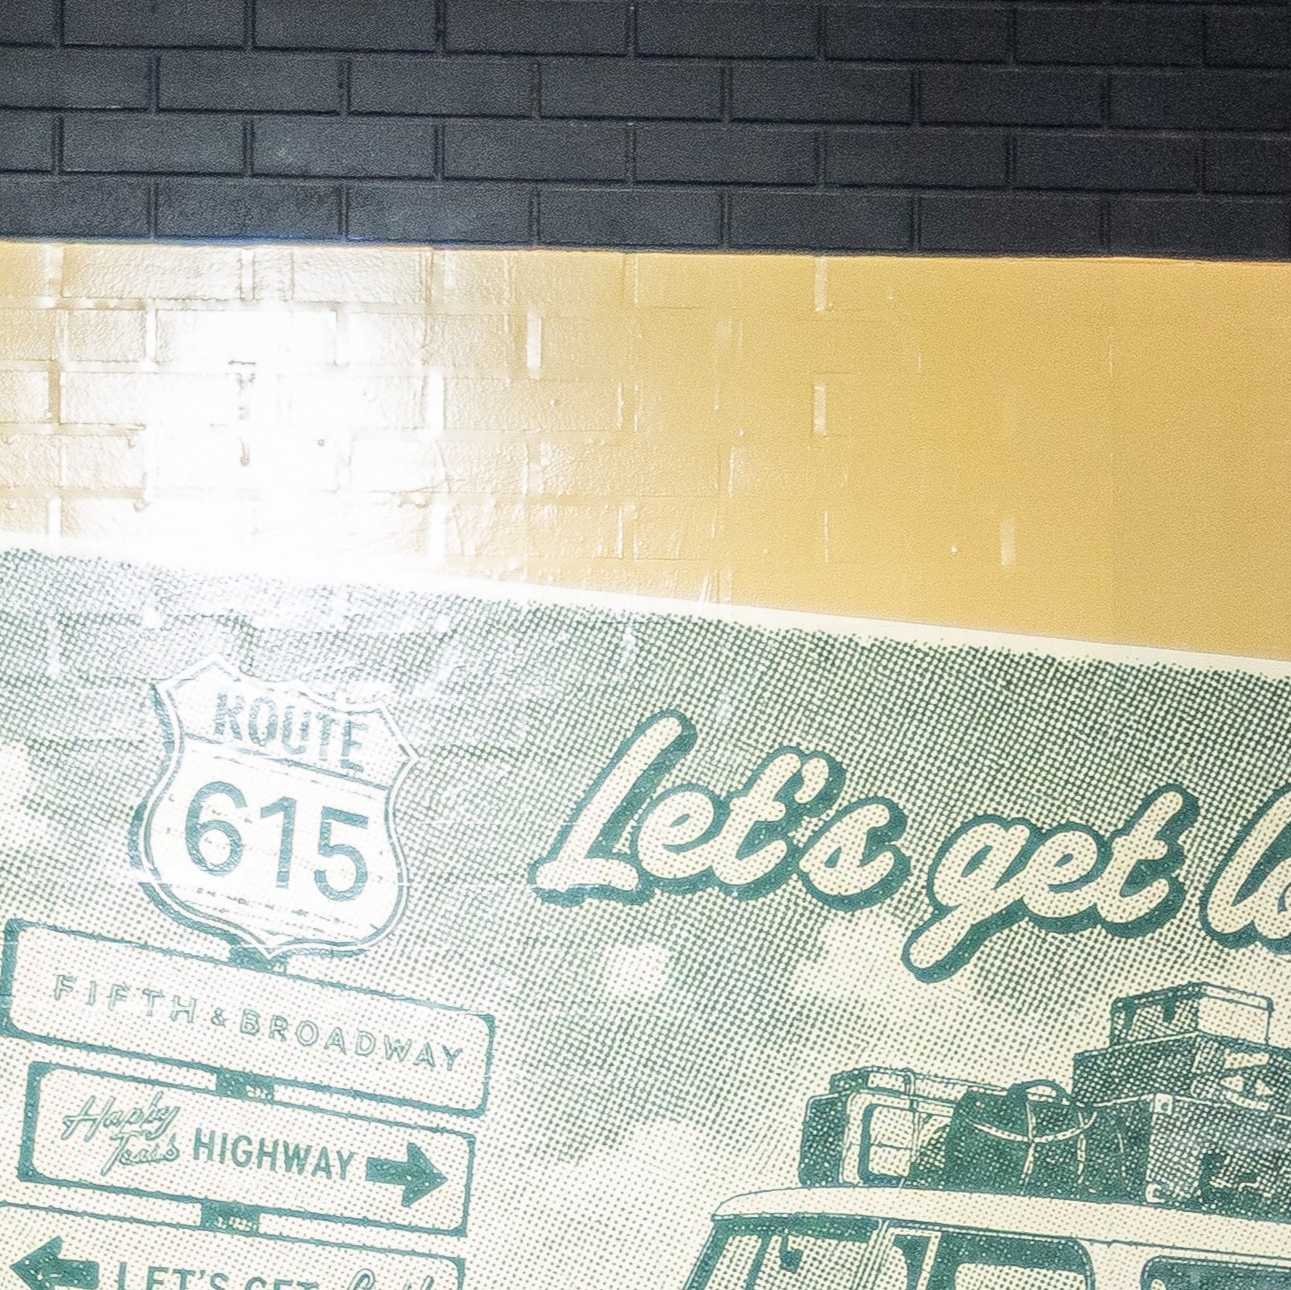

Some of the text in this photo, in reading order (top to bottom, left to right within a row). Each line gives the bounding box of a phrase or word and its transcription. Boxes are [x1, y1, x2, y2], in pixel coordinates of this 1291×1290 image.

[214, 691, 370, 774] ROUTE
[184, 780, 371, 902] 615
[529, 708, 909, 910] Let's
[900, 782, 1189, 983] get
[52, 973, 198, 1024] FIFTH
[238, 1008, 464, 1073] BROADWAY
[192, 1127, 356, 1182] HIGHWAY
